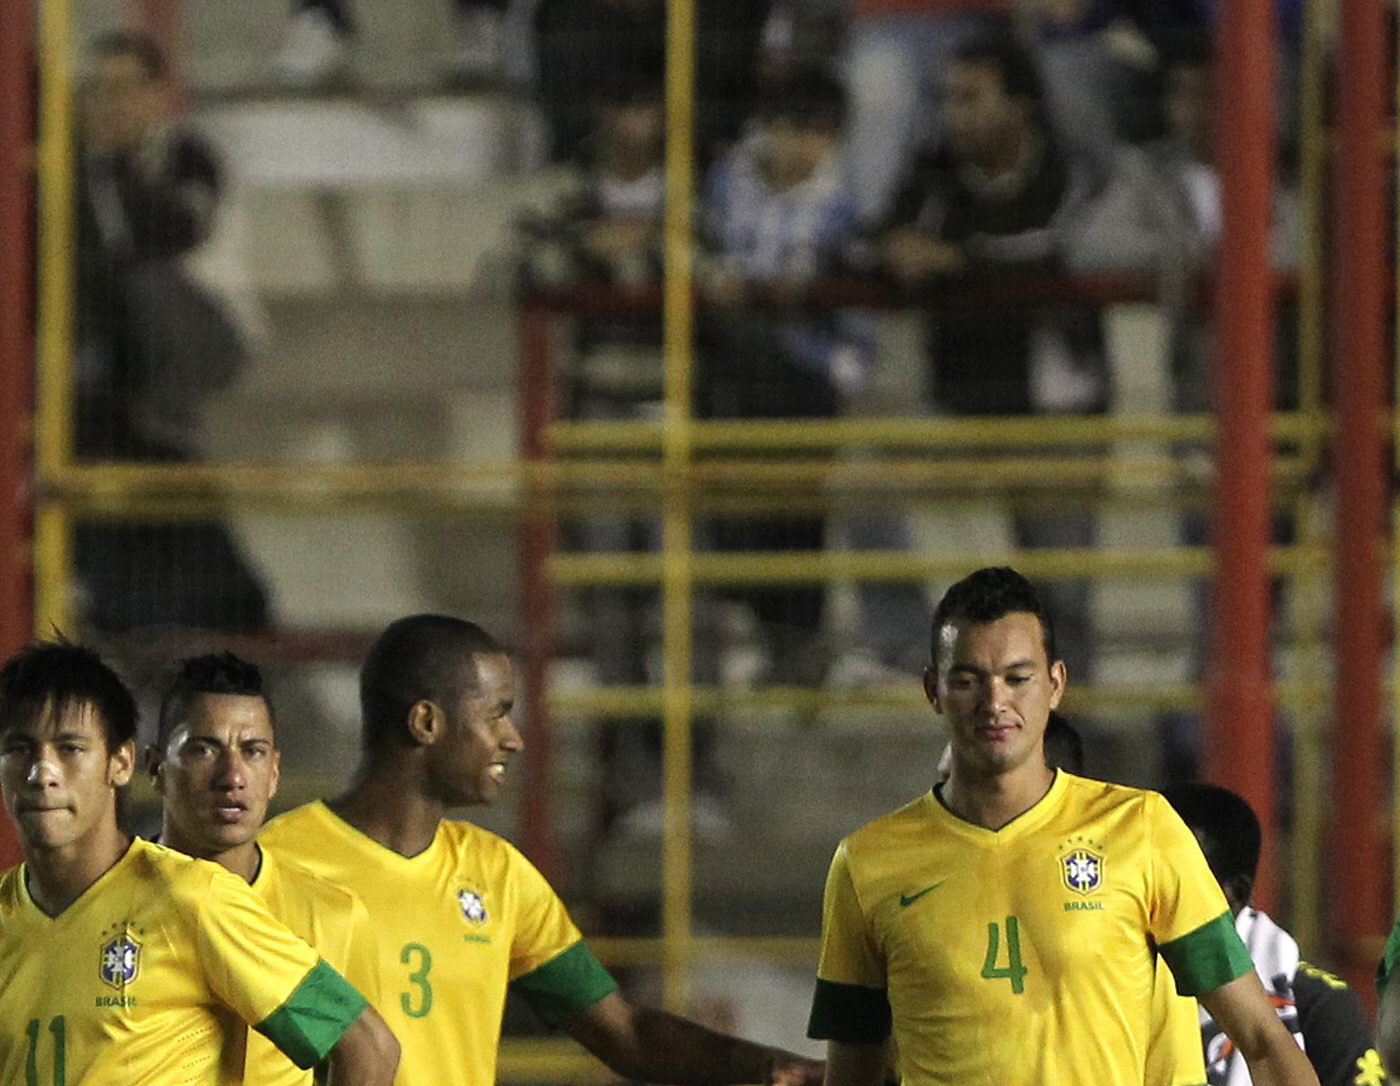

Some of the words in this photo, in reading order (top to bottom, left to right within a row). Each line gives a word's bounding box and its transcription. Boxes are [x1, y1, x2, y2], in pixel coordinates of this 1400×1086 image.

[1064, 901, 1104, 911] BRASIL
[401, 942, 432, 1018] 3
[981, 915, 1028, 994] 4
